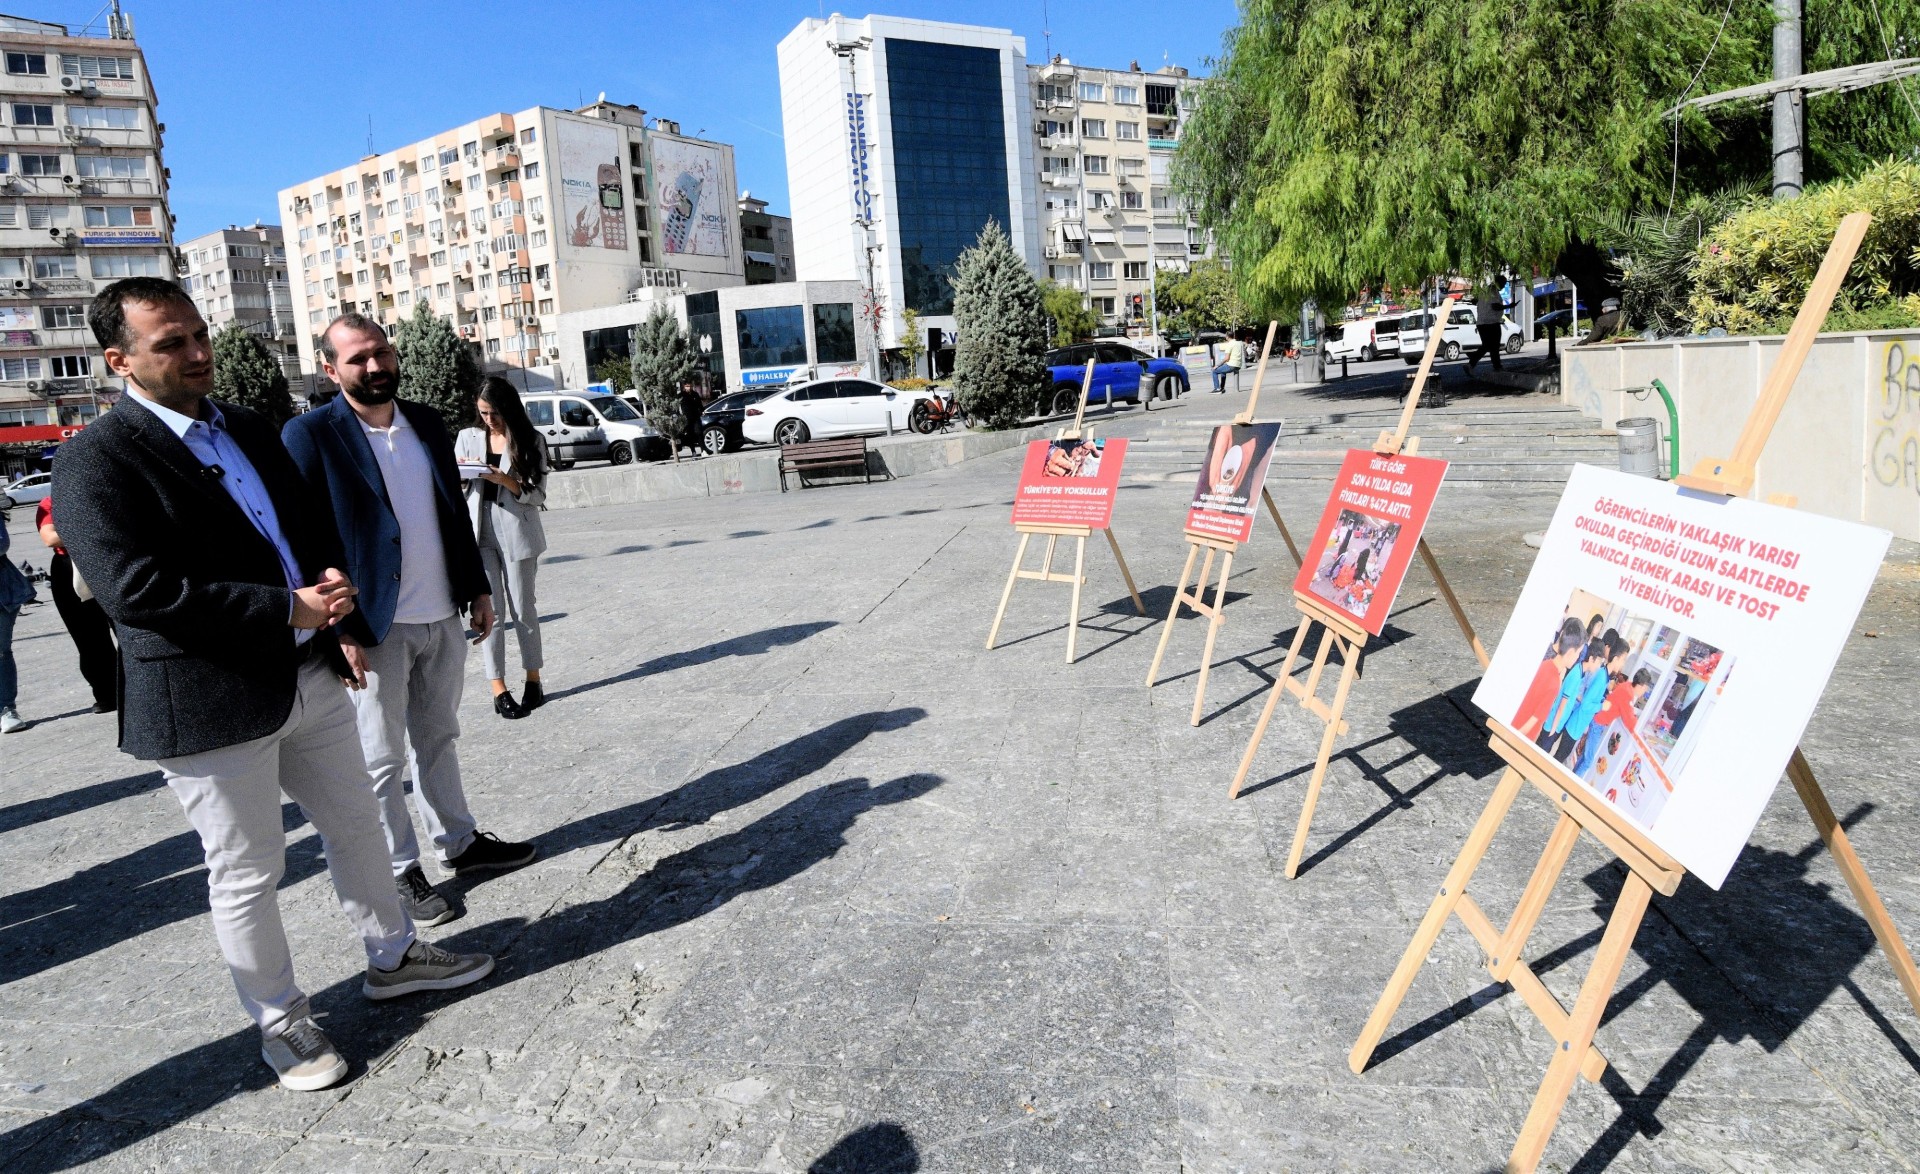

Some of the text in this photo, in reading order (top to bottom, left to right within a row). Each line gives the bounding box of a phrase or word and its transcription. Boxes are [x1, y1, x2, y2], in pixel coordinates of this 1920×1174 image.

[562, 179, 592, 189] NOKIA
[758, 372, 793, 381] HALKBA
[61, 428, 84, 438] CA
[1387, 461, 1406, 474] GÖRE
[1023, 485, 1109, 496] TÜRKİYE'DE YOKSULLUK
[1351, 474, 1366, 485] SON
[1371, 478, 1391, 492] YILDA
[1392, 482, 1413, 497] GIDA
[1339, 488, 1370, 507] FİYATLARI
[1594, 496, 1801, 570] ÖĞRENCİLERİN YAKLAŞIK YARISI
[1574, 515, 1811, 602] OKULDA GEÇİRDİĞİ UZUN SAATLERDE
[1579, 538, 1781, 621] YALNIZCA EKMEK ARASI VE TOST
[1618, 574, 1696, 620] YİYEBİLİYOR.
